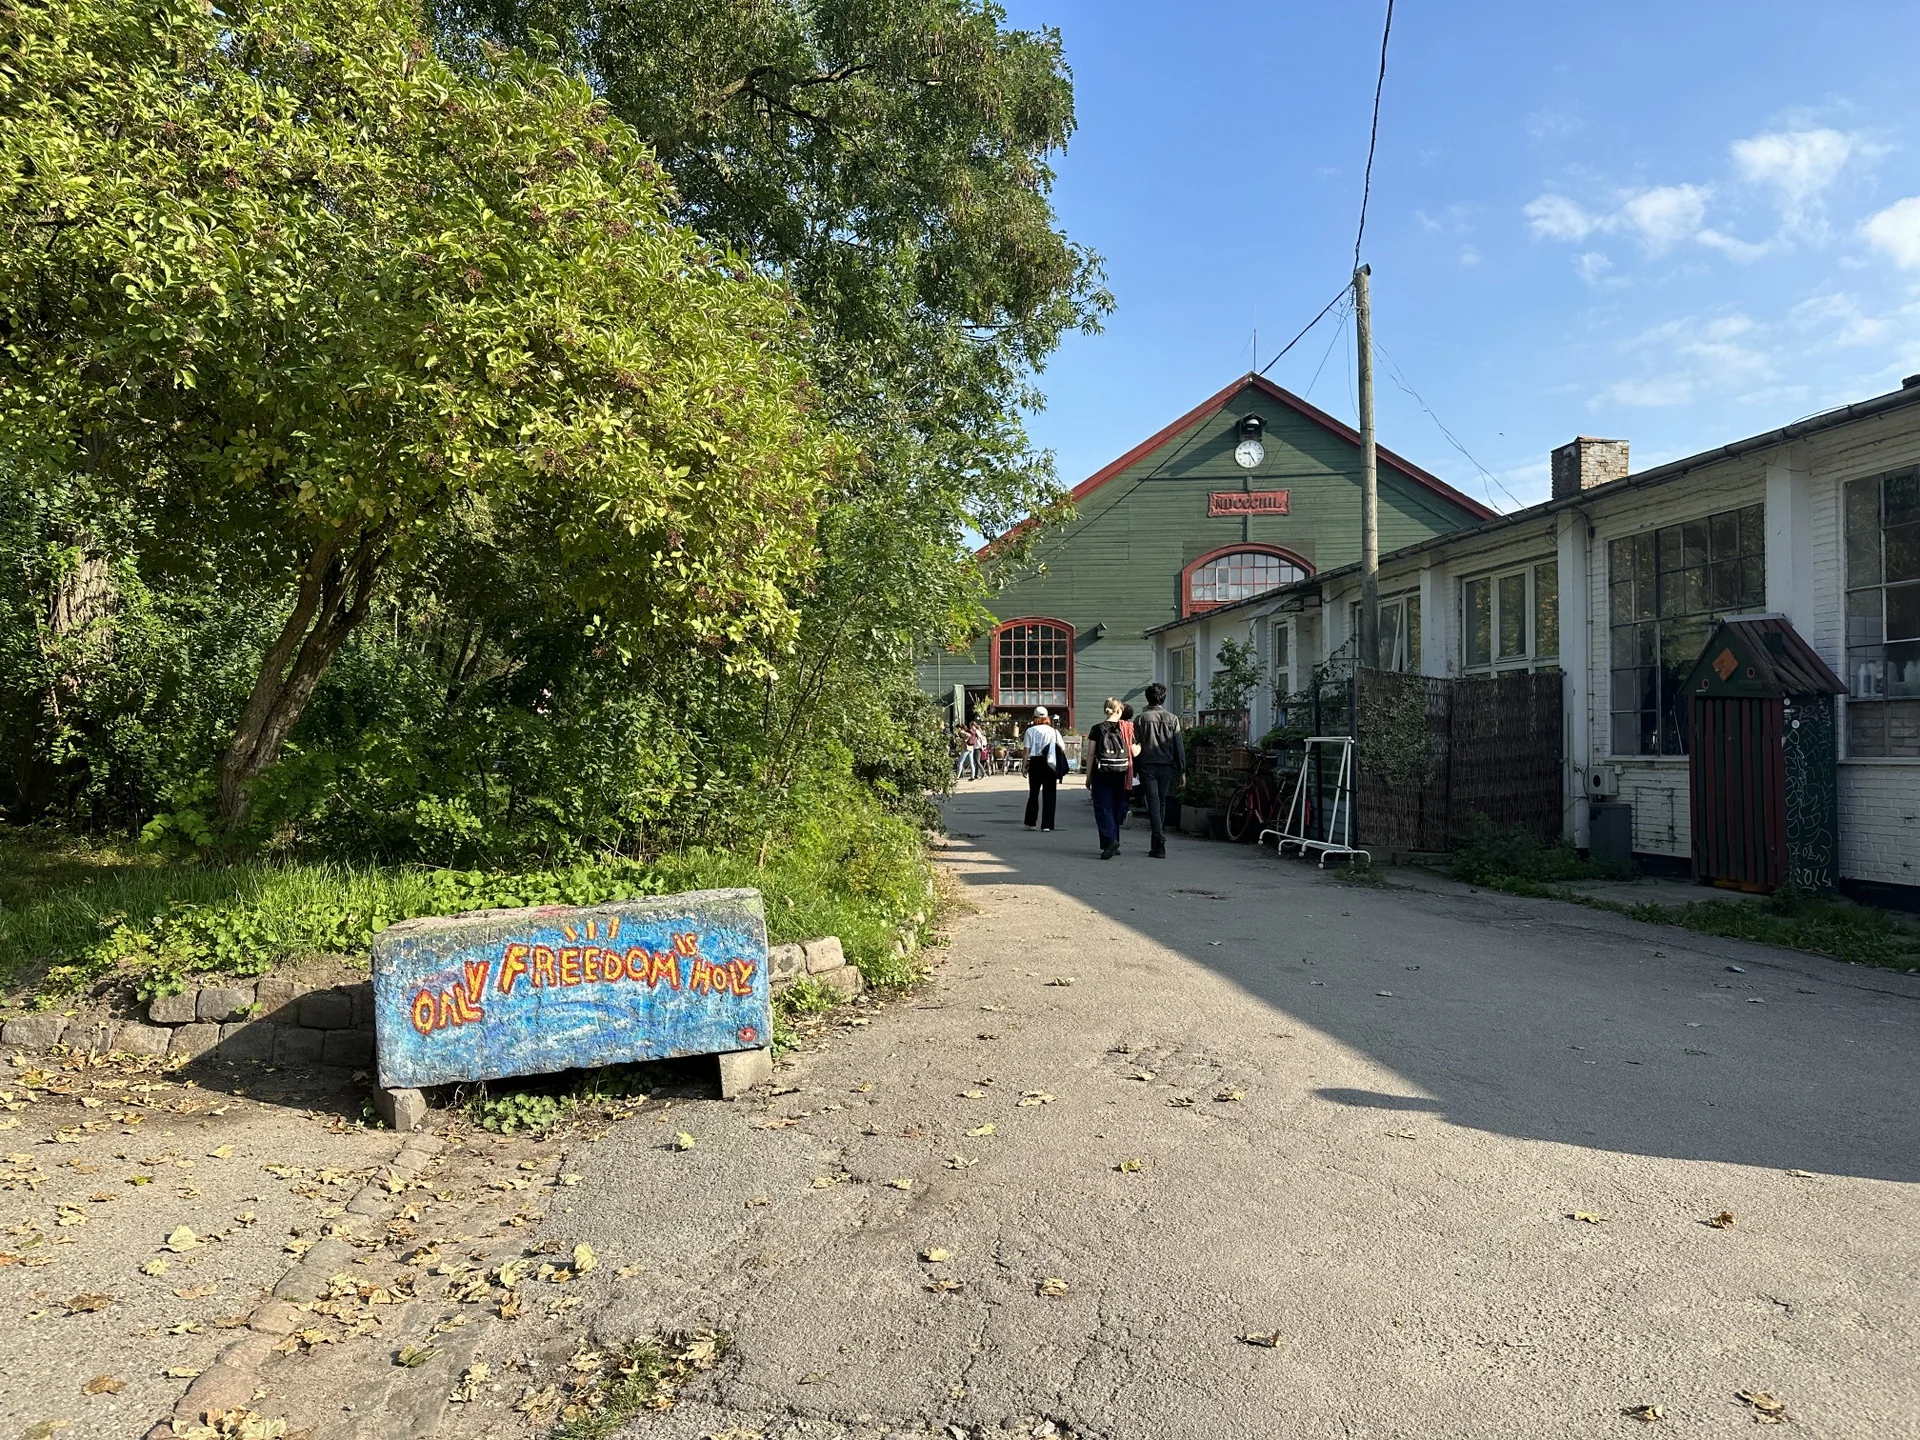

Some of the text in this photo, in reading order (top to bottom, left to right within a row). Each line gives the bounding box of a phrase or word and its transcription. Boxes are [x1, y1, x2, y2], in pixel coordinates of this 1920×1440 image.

[412, 961, 489, 1034] ONLY
[498, 943, 680, 994] FREEDOM
[690, 958, 755, 996] HOLY
